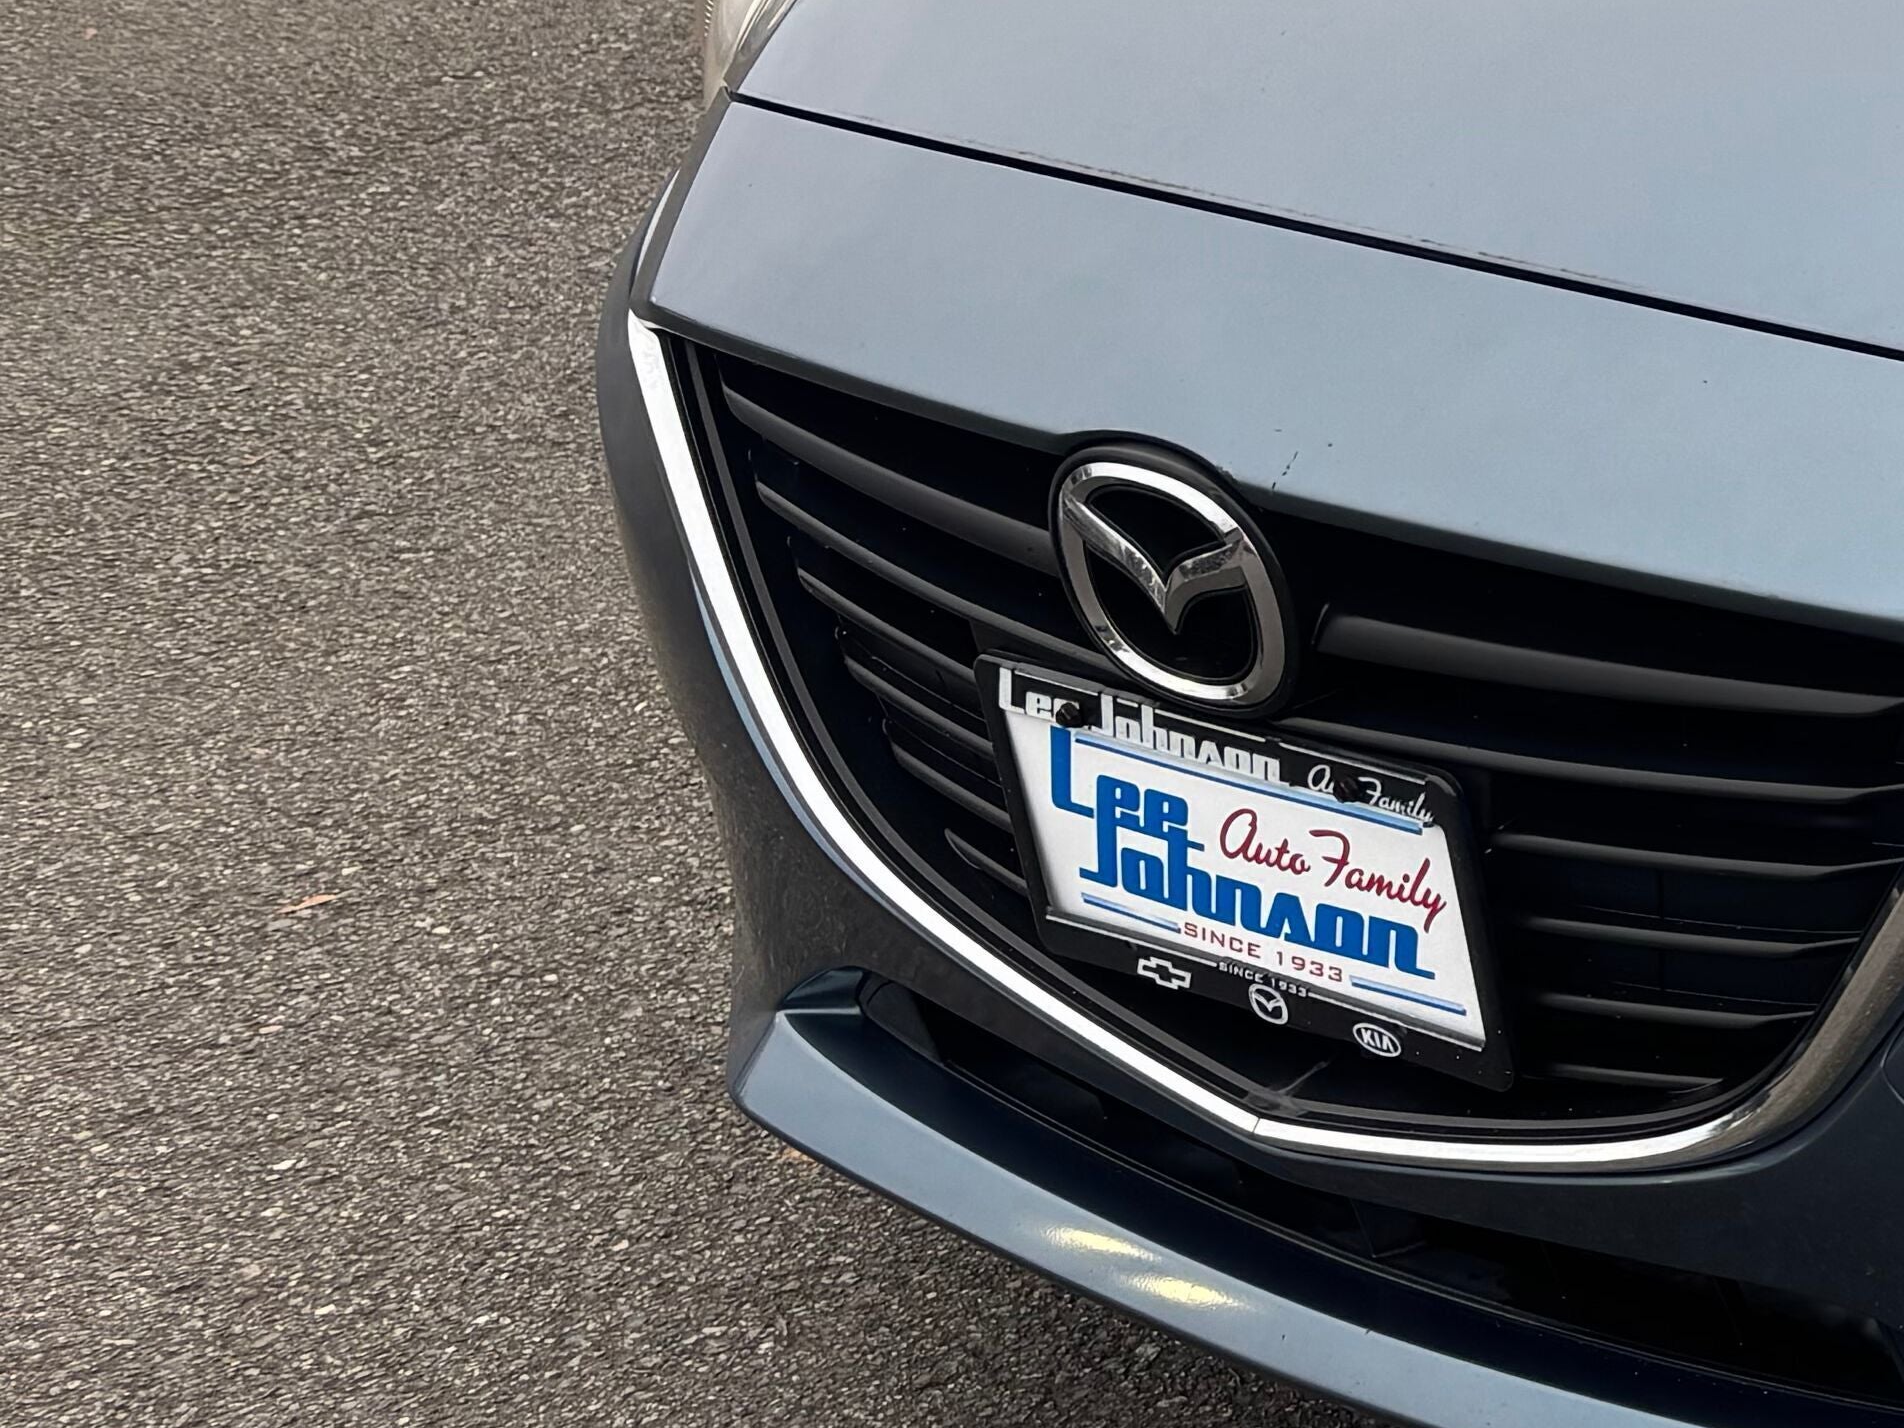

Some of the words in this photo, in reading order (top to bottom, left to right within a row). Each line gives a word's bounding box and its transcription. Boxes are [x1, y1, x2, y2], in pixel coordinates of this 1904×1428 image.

[1050, 724, 1205, 852] Lee
[1089, 692, 1291, 786] Johnson
[1358, 776, 1435, 824] Family
[1079, 776, 1436, 980] Johnson
[1219, 808, 1311, 875] Auto
[1308, 829, 1447, 934] Family
[1184, 922, 1262, 960] SINCE
[1275, 951, 1344, 983] 1933
[1218, 961, 1265, 984] SINCE
[1270, 977, 1309, 998] 1933
